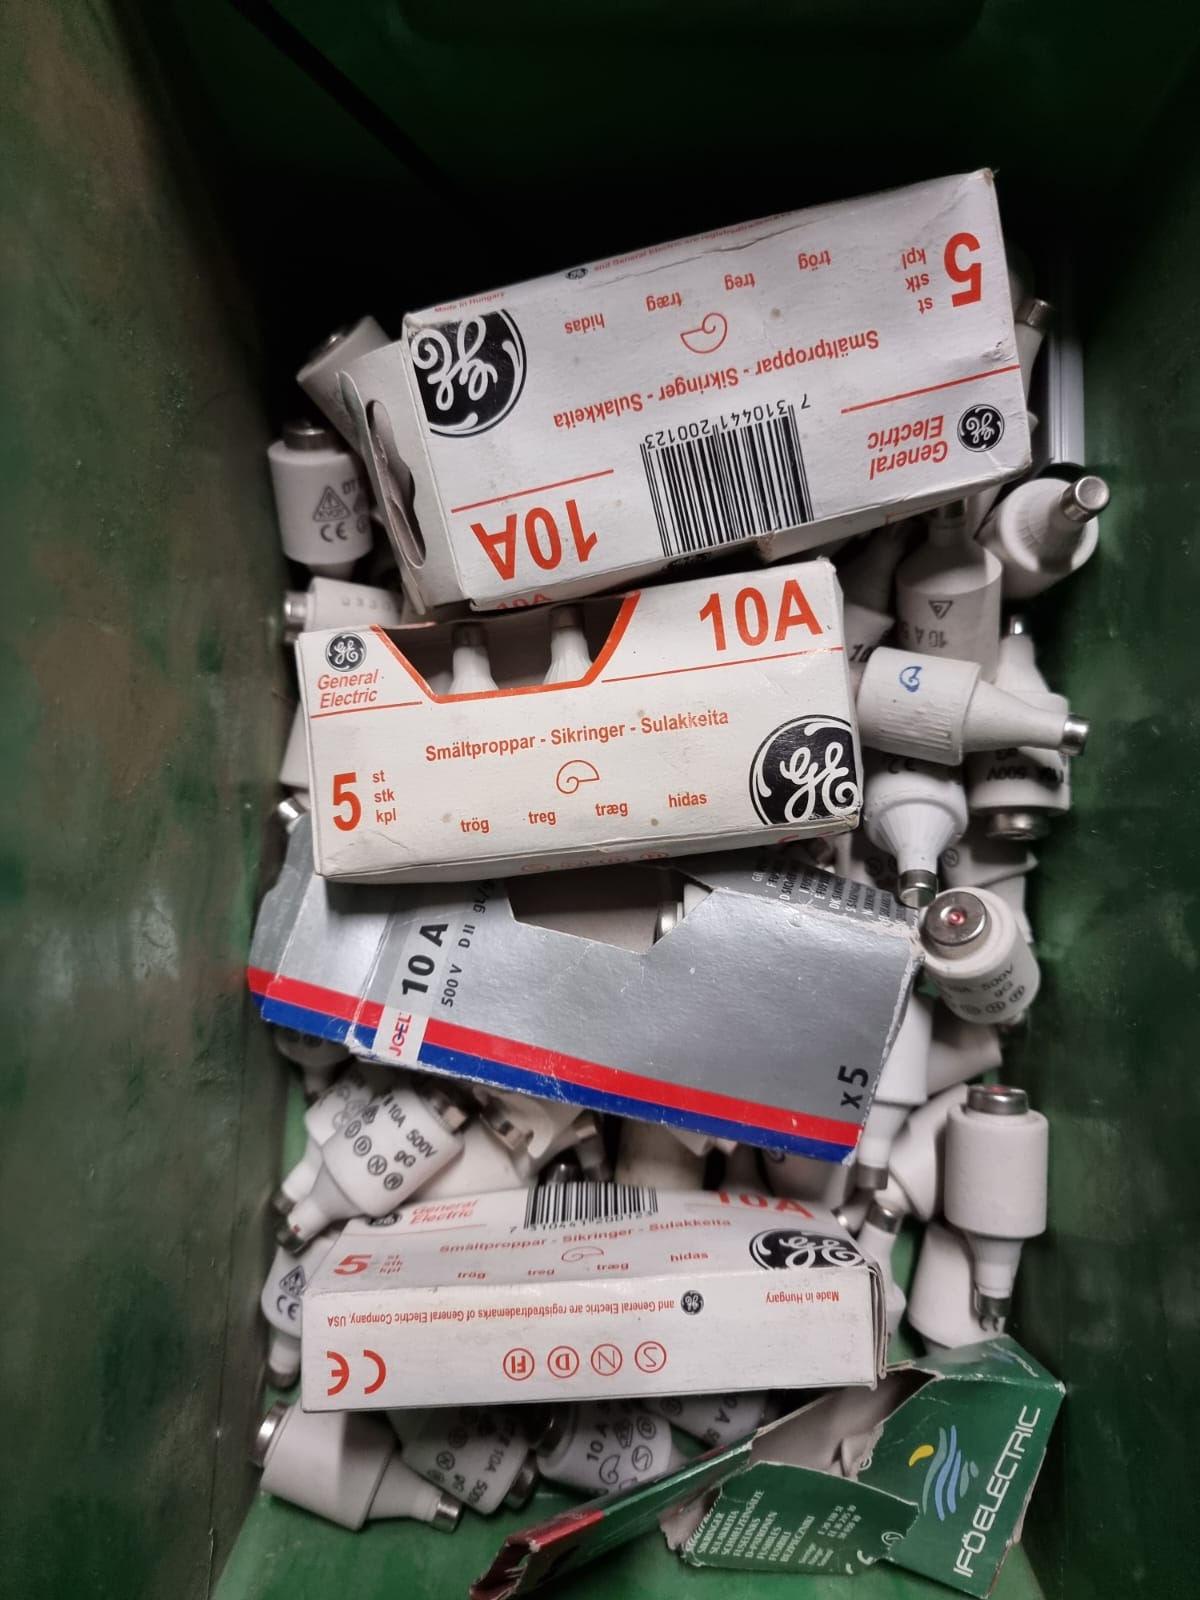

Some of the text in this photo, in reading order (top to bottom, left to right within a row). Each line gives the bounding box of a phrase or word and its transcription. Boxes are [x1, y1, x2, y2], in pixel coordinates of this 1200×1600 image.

[797, 250, 831, 271] trög
[902, 248, 927, 269] kpl
[944, 232, 982, 308] 5
[724, 272, 755, 291] treg
[905, 273, 930, 292] stk
[646, 292, 682, 312] træg
[918, 297, 934, 314] st
[564, 313, 605, 335] hidas
[755, 330, 880, 377] Smältproppar
[658, 367, 738, 404] Sikringer
[553, 393, 643, 430] Sulakkeita
[644, 393, 811, 450] 7 310441 200123
[867, 415, 945, 450] Electric
[868, 440, 949, 480] General
[470, 499, 598, 580] 10A
[699, 579, 823, 652] 10A
[317, 668, 380, 690] General
[319, 688, 378, 709] Electric
[425, 734, 536, 762] Smältproppar
[551, 723, 626, 745] Sikringer
[641, 709, 729, 734] Sulakkeita
[372, 770, 385, 784] st
[332, 771, 362, 832] 5
[374, 788, 396, 804] stk
[668, 792, 708, 809] hidas
[375, 808, 397, 825] kpl
[528, 809, 557, 826] treg
[595, 802, 629, 817] træg
[460, 817, 490, 834] trög
[457, 936, 471, 949] D
[401, 922, 449, 997] 10 A
[449, 963, 463, 976] V
[440, 977, 460, 1008] 500
[837, 1064, 868, 1109] x 5
[406, 1128, 438, 1159] 500V
[393, 1149, 417, 1169] gG
[412, 1200, 477, 1216] General
[410, 1210, 475, 1226] Electric
[440, 1237, 548, 1253] Smältproppar
[561, 1227, 634, 1244] Sikringer
[649, 1218, 732, 1233] Sulakkeita
[334, 1254, 373, 1276] 5
[669, 1250, 709, 1262] hidas
[457, 1272, 488, 1281] trög
[586, 1301, 619, 1313] Electric
[621, 1300, 656, 1312] General
[658, 1299, 675, 1309] and
[765, 1290, 840, 1305] Made in Hungary
[350, 1312, 392, 1325] Company,
[394, 1311, 428, 1323] Electric
[430, 1310, 464, 1322] General
[466, 1309, 476, 1319] of
[568, 1306, 584, 1314] are
[327, 1316, 347, 1327] USA
[326, 1350, 387, 1396] CE
[586, 1440, 605, 1462] 10
